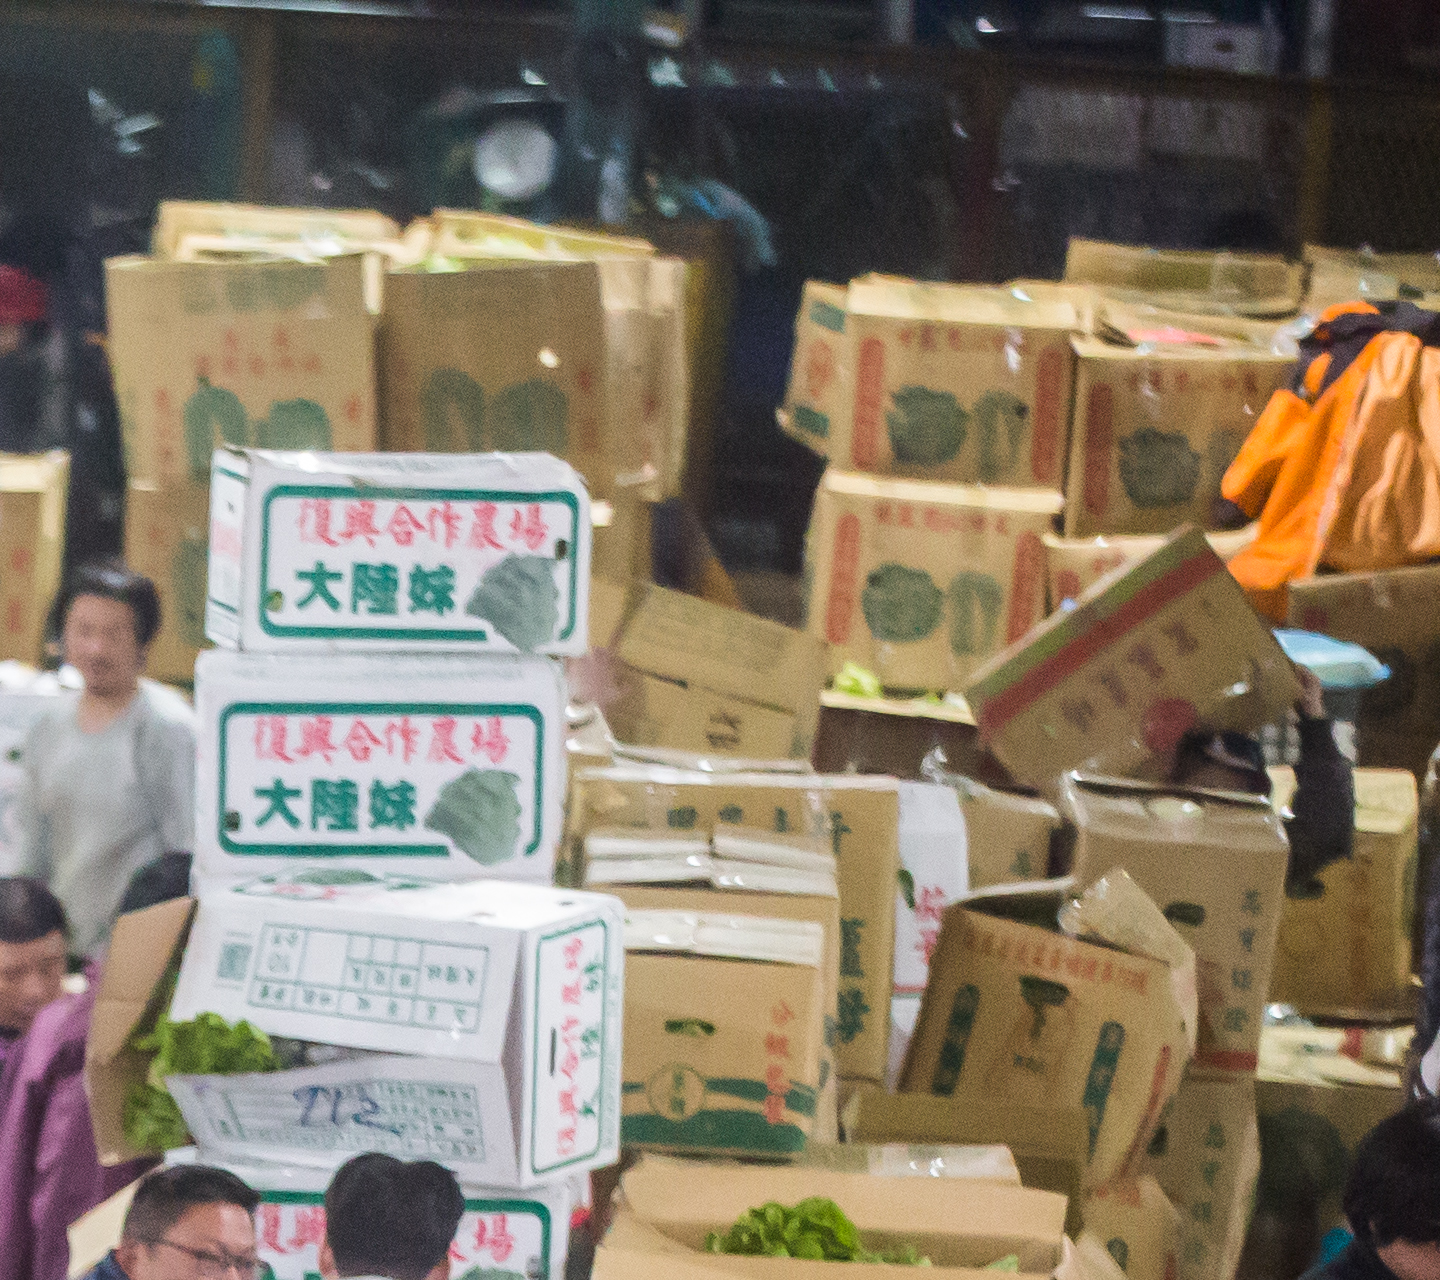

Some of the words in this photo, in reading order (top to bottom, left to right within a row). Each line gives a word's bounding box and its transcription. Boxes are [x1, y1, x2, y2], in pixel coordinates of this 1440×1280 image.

[296, 560, 457, 617] 大陸妹
[254, 778, 417, 833] 大陸妹
